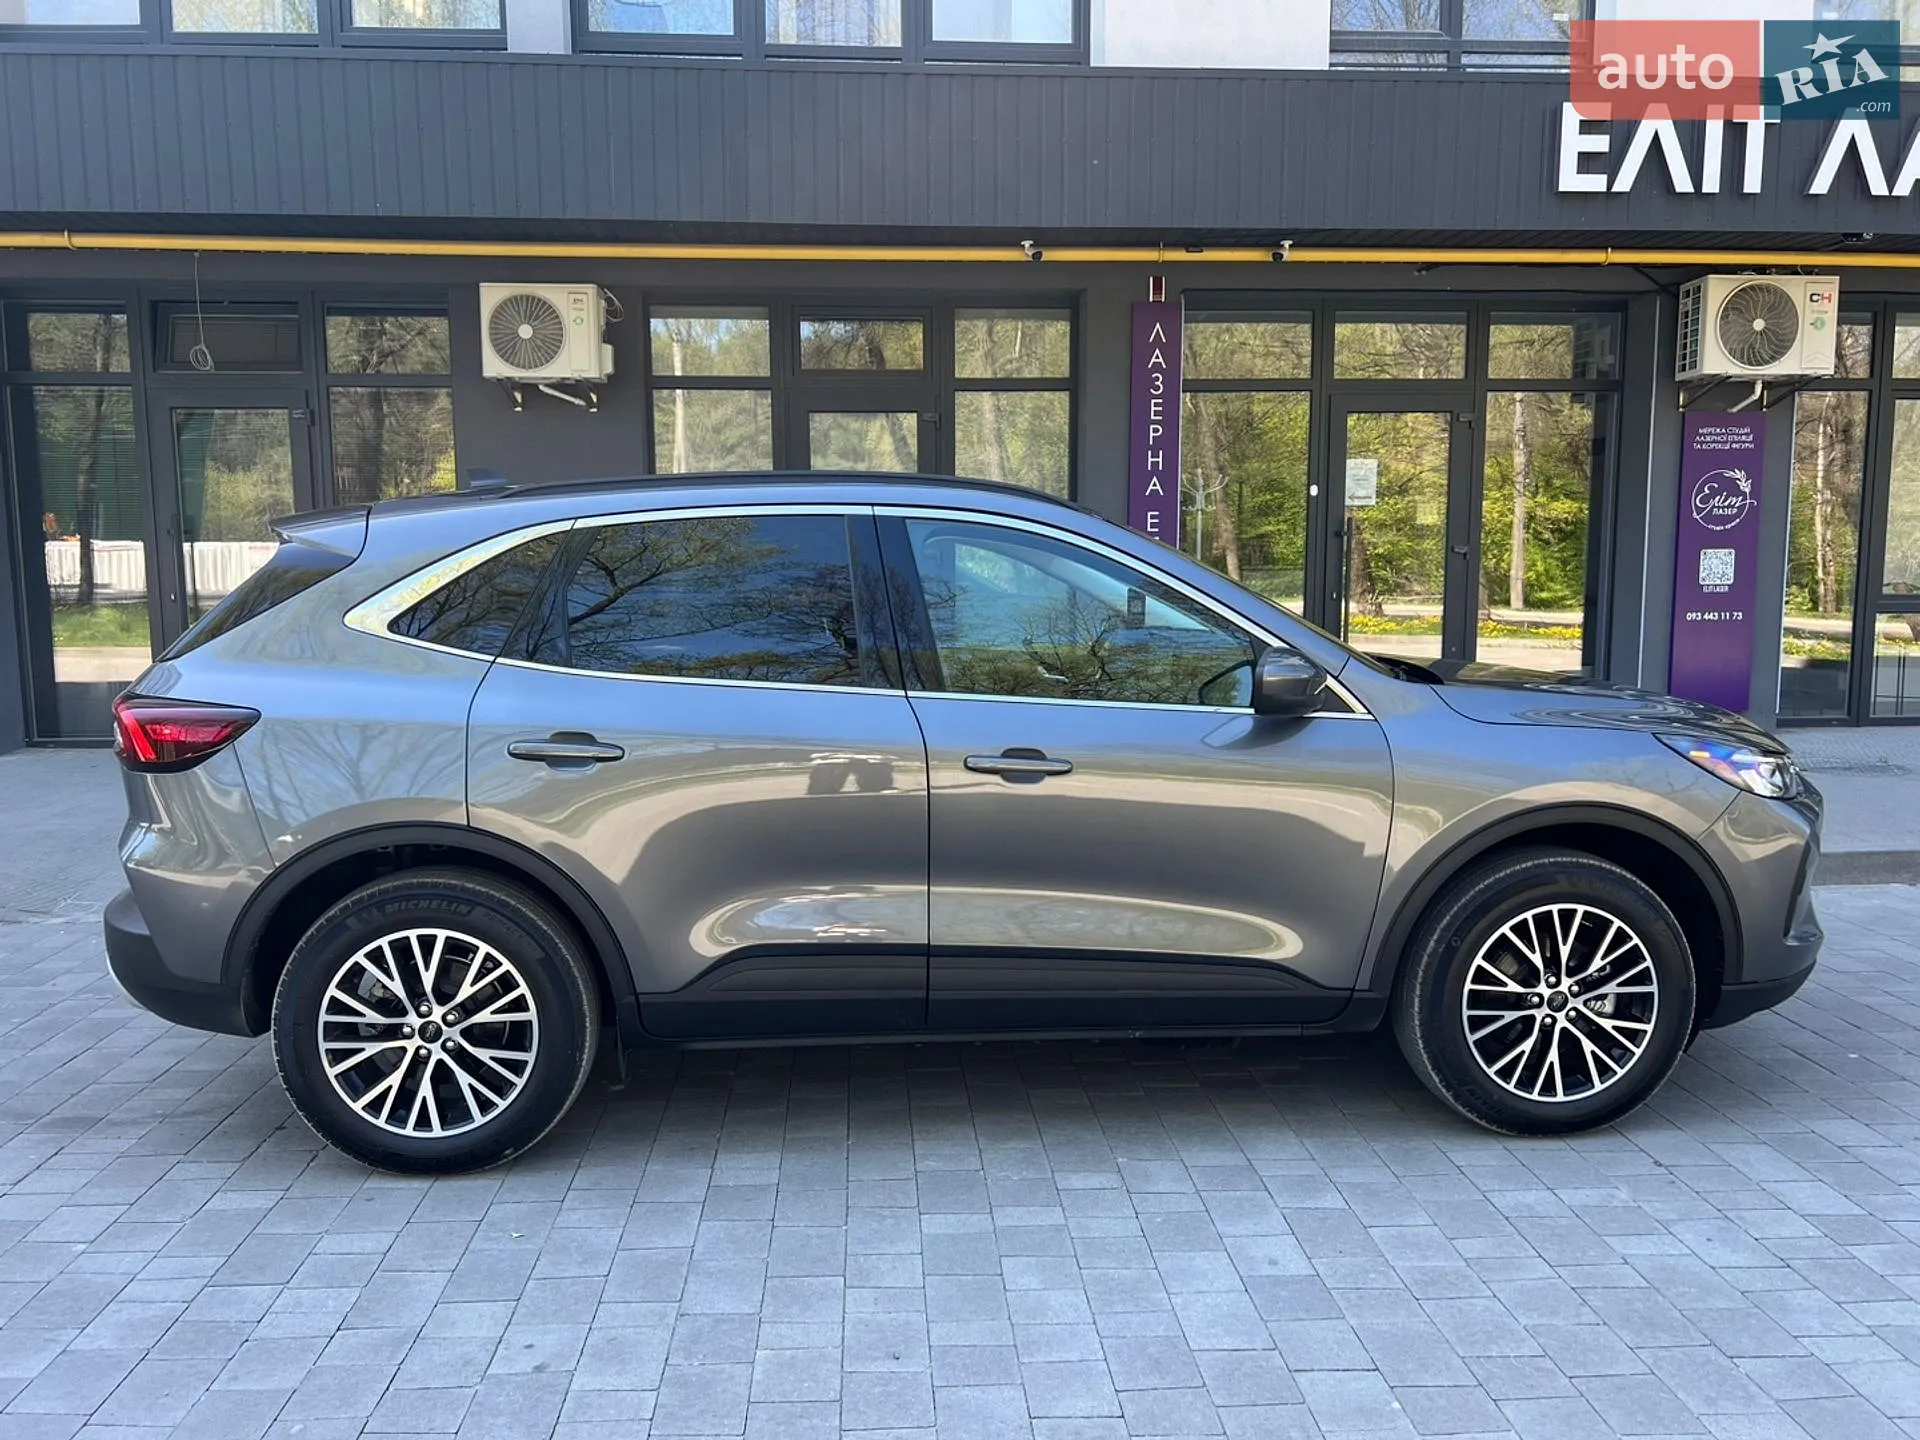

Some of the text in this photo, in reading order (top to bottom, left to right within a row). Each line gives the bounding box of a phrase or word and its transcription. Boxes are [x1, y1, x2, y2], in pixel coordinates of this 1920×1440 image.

[1145, 322, 1167, 540] ЛАЗЕРНА Е
[1686, 611, 1743, 620] 093 443 11 73
[385, 899, 472, 917] MICHELIN
